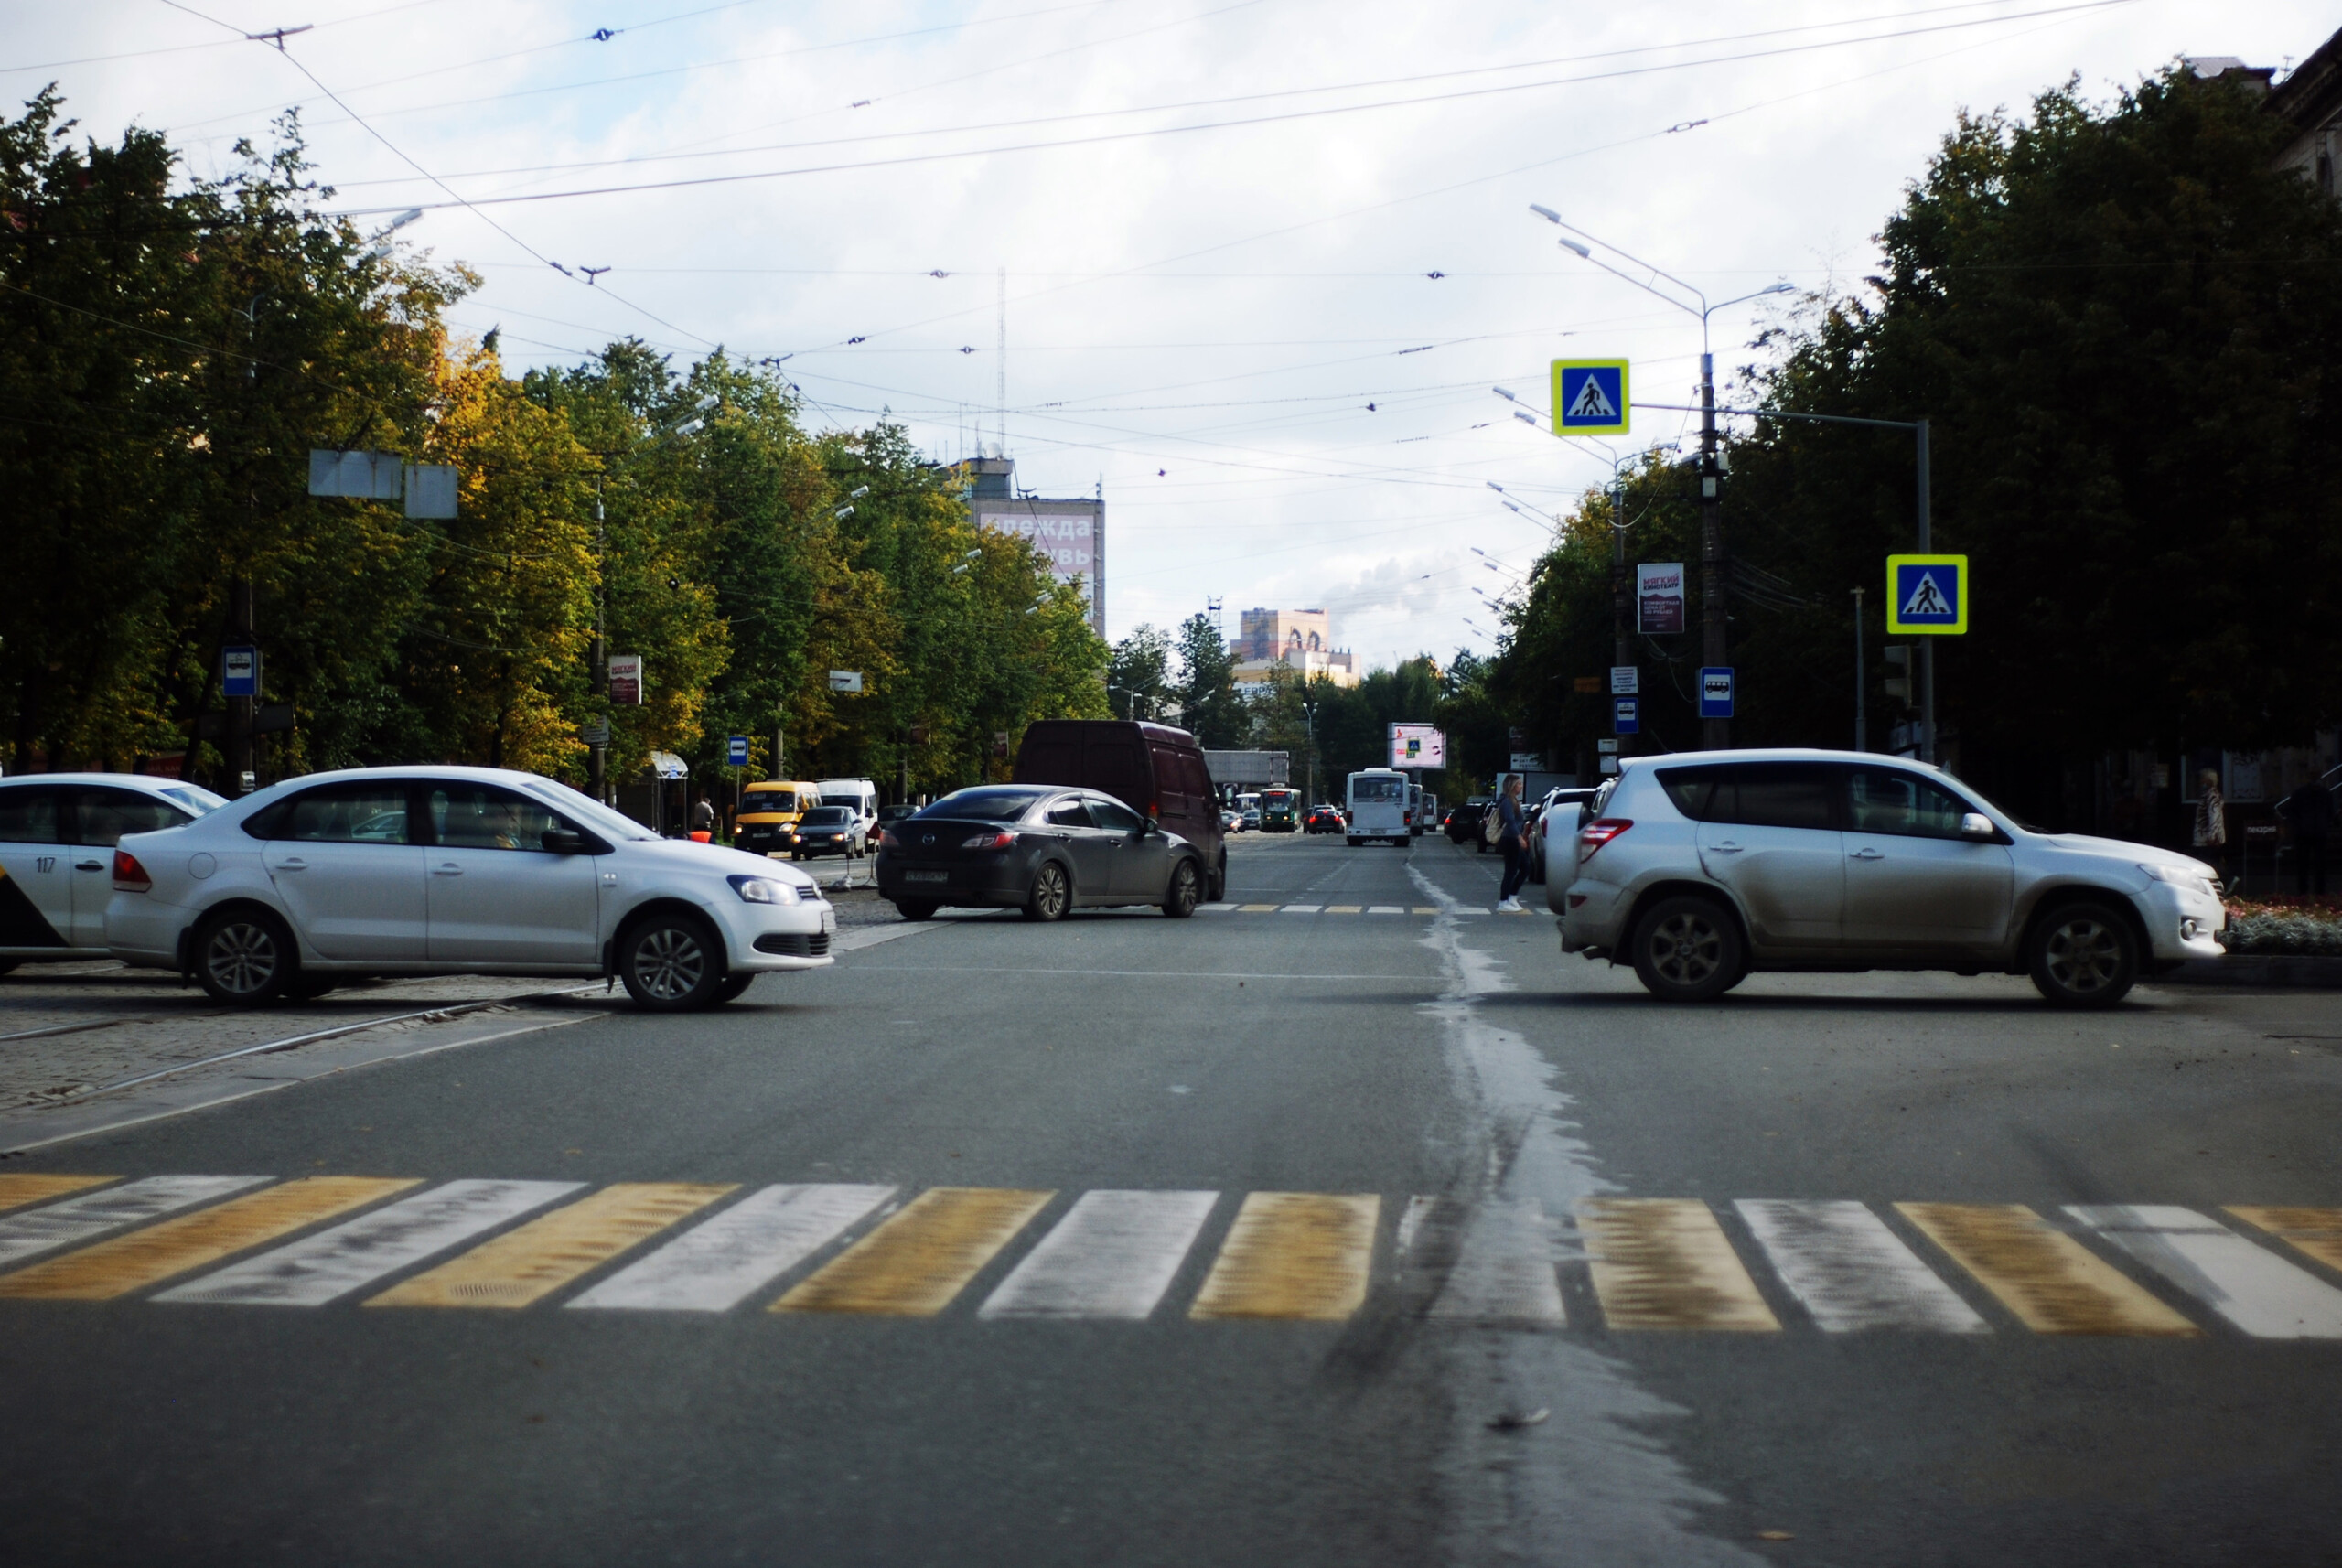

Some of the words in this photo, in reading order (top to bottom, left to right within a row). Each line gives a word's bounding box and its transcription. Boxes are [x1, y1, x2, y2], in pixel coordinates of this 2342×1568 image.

[1643, 572, 1680, 585] МЯГКИЙ
[1643, 583, 1680, 591] КИНОТЕАТР
[37, 857, 56, 873] 117
